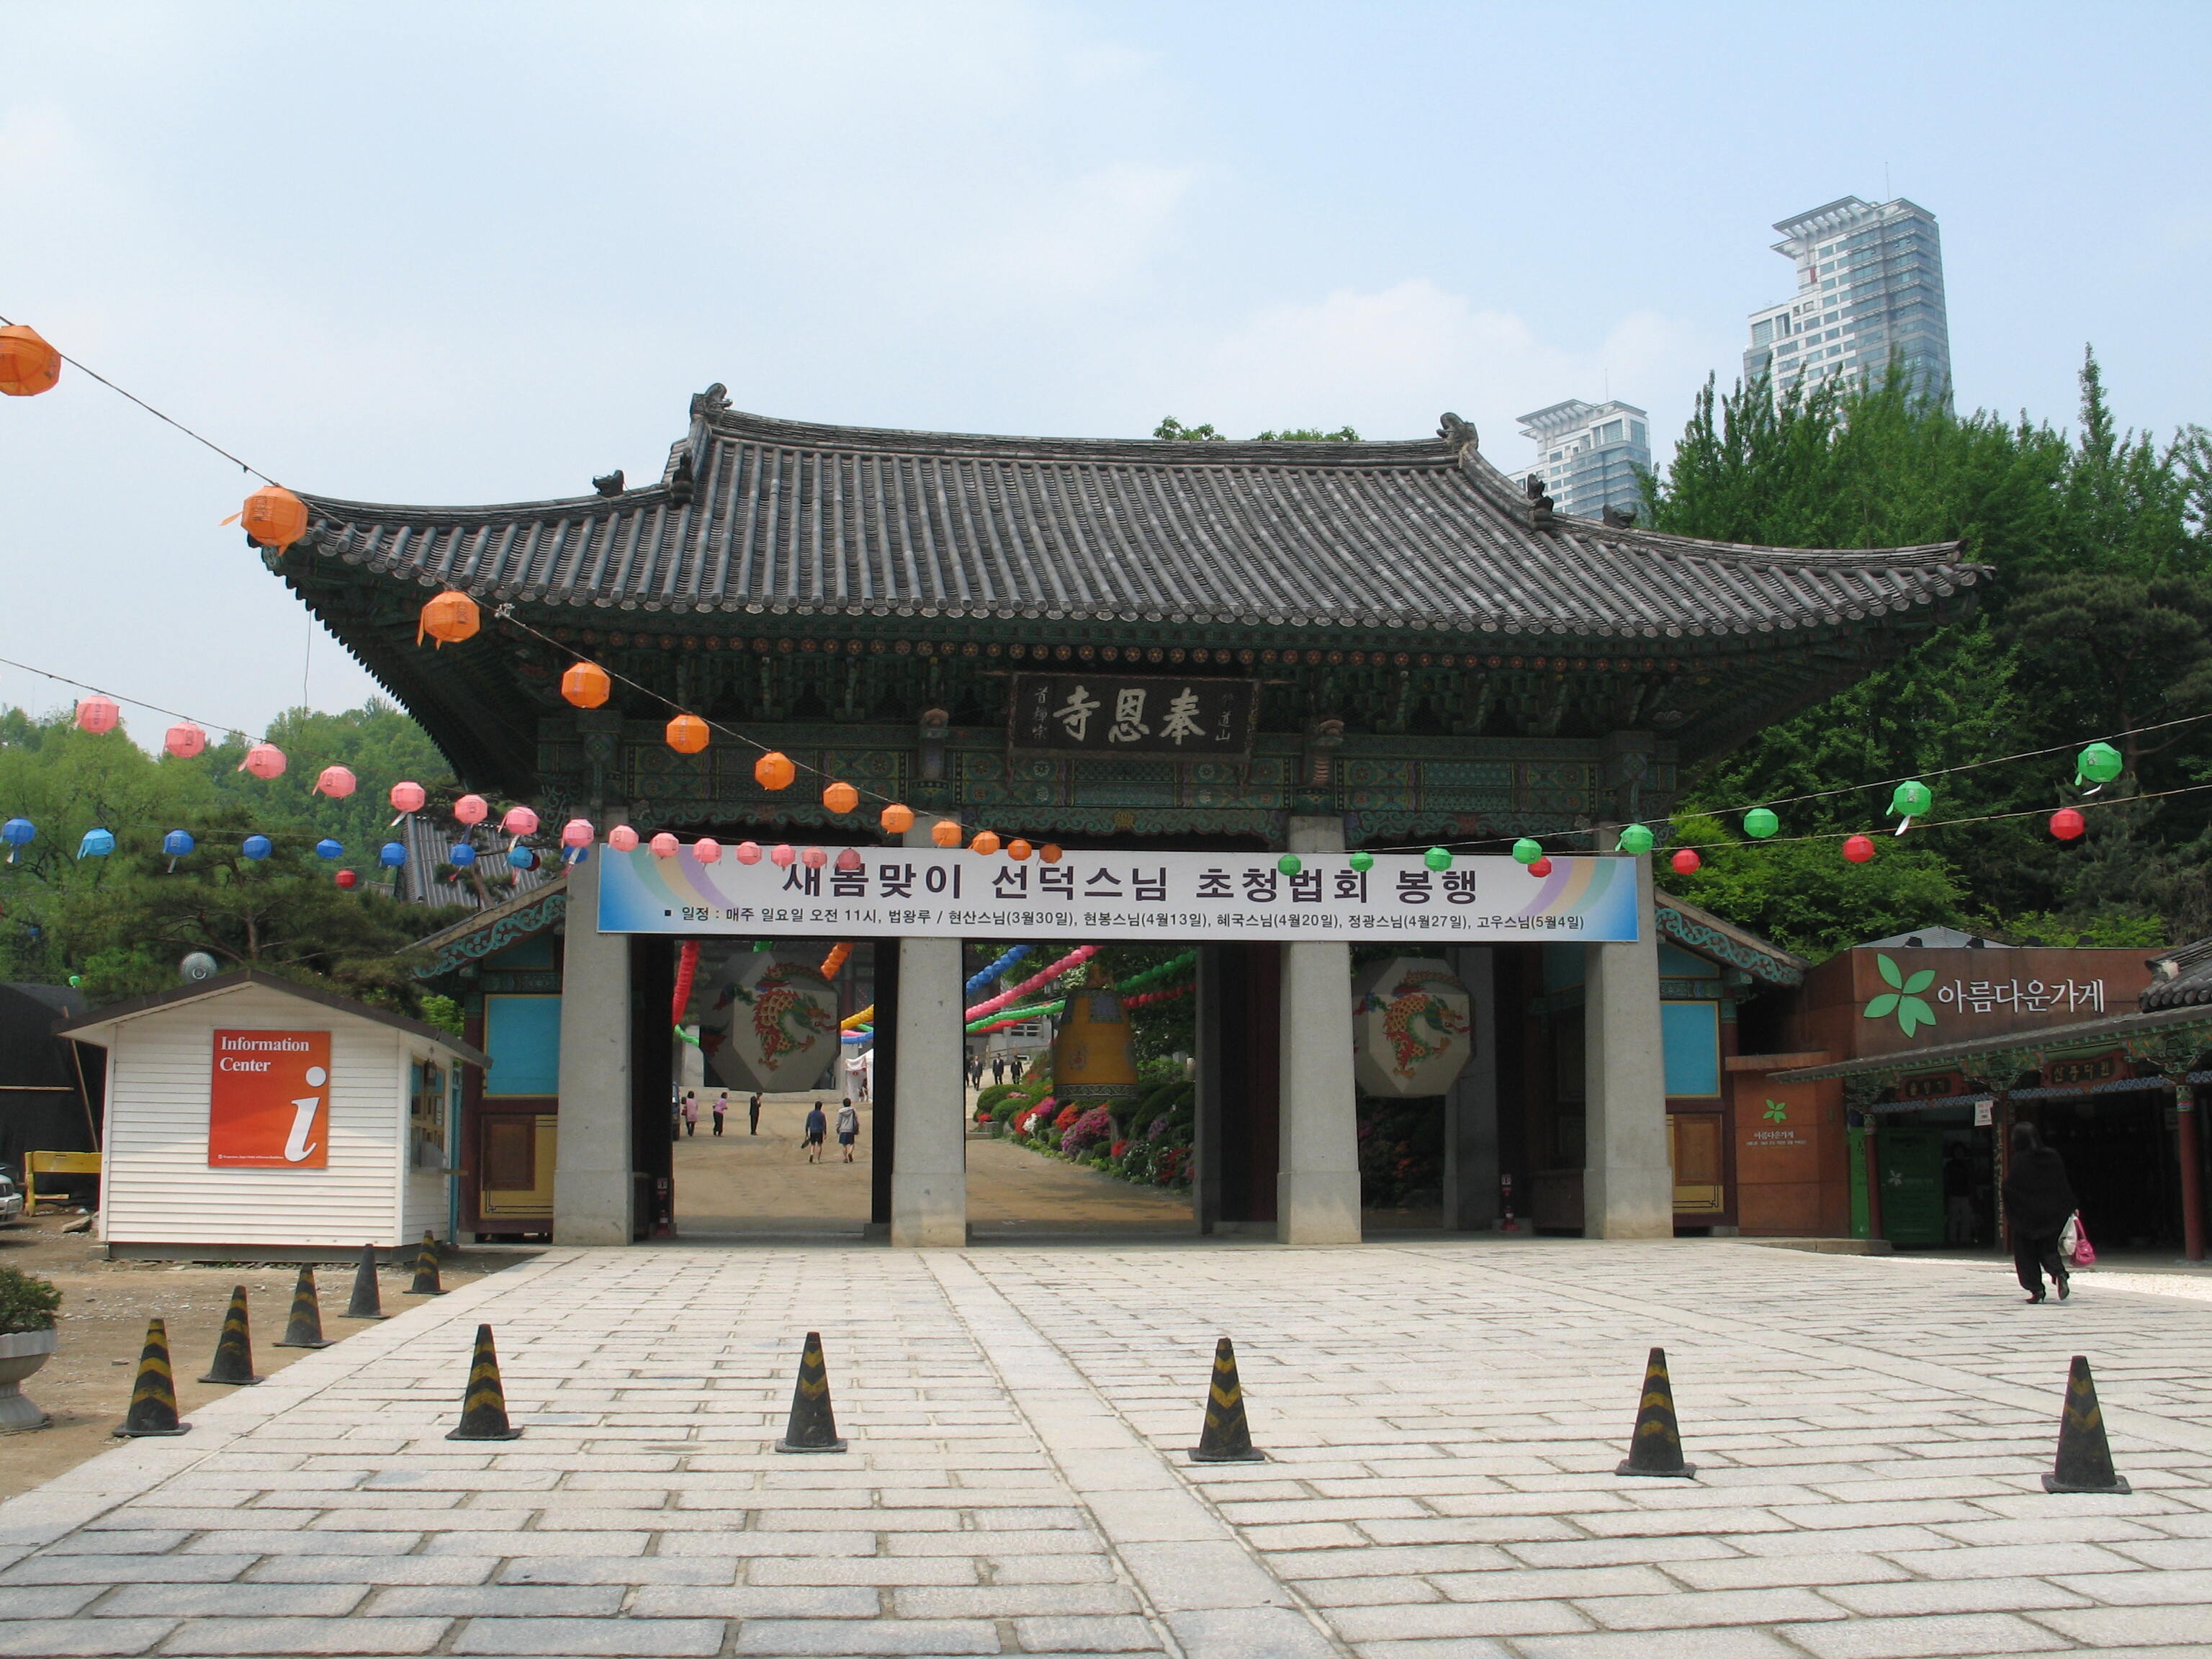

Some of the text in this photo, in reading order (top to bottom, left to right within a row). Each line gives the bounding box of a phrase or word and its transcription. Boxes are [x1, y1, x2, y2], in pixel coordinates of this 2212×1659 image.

[782, 863, 1476, 904] 새봄맞이 선덕스님 초청법회 봉행
[681, 906, 709, 921] 일정
[726, 907, 755, 922] 매주
[761, 907, 804, 922] 일요일
[809, 909, 838, 922] 오전
[845, 909, 882, 924] 11시,
[888, 909, 932, 924] 법왕루
[1476, 916, 1585, 930] 고우스님(5월4일)
[1937, 979, 2105, 1013] 아름다운가게
[220, 1036, 310, 1052] Information
[219, 1056, 271, 1072] Center
